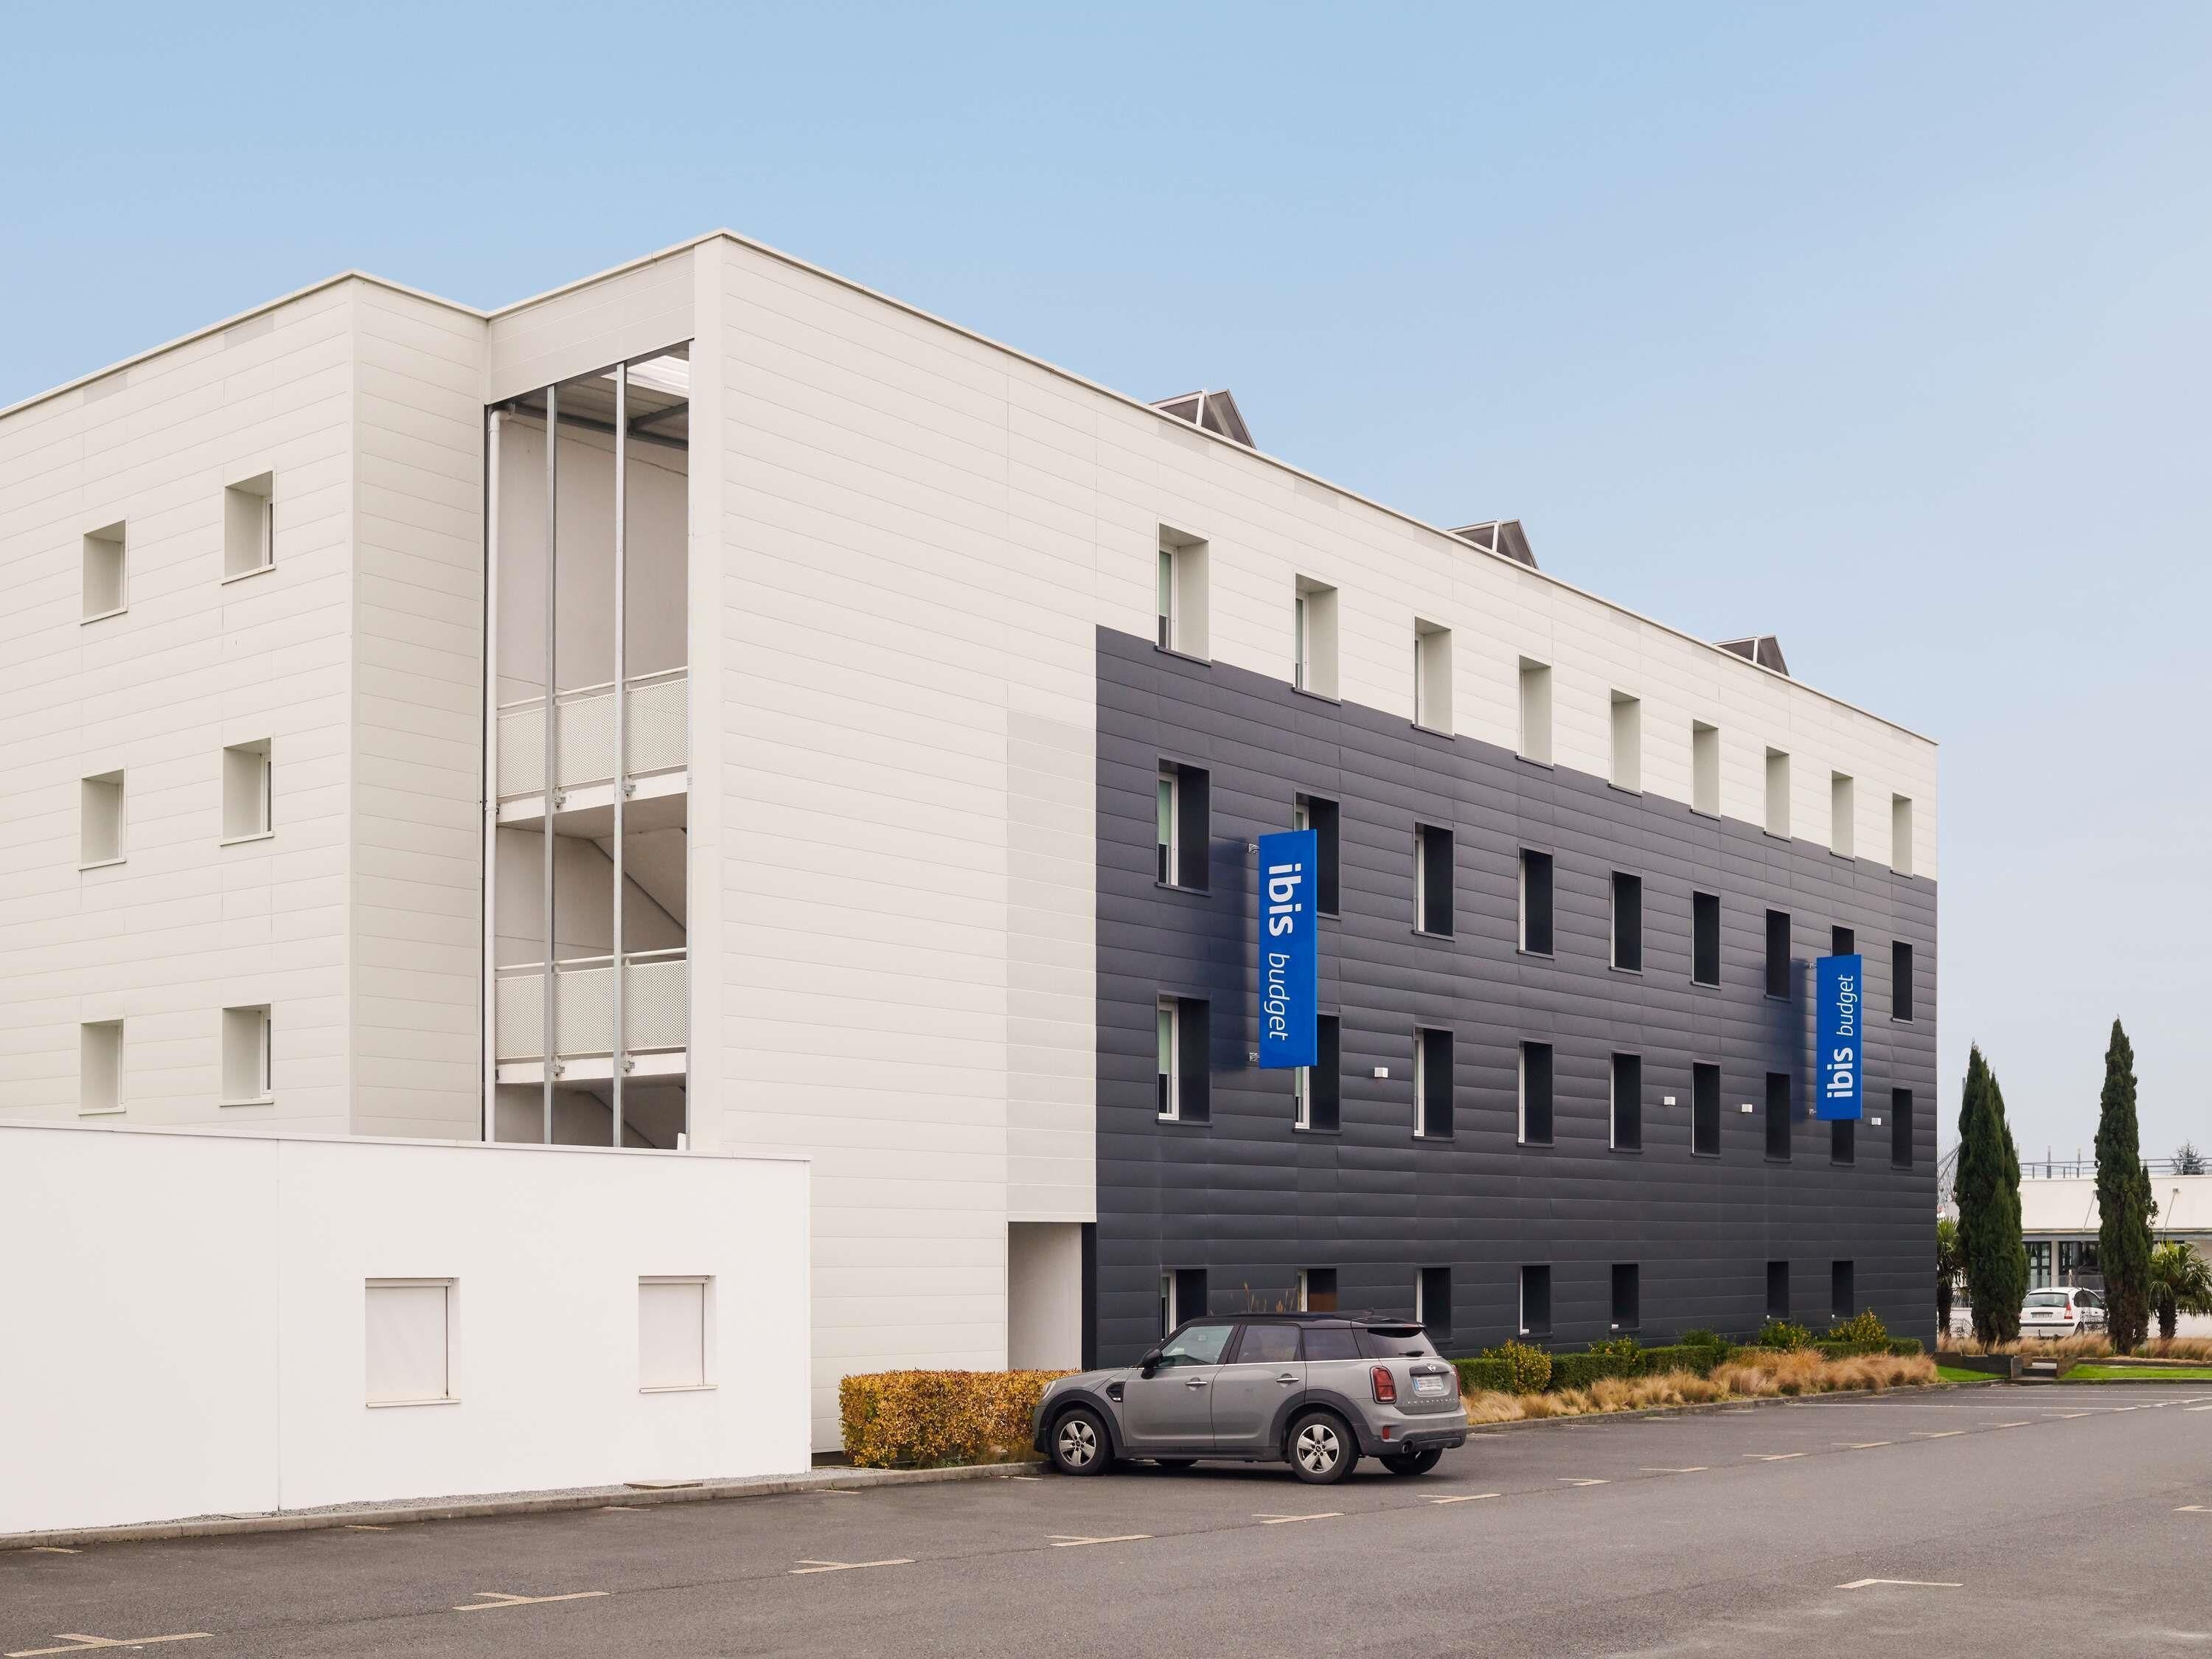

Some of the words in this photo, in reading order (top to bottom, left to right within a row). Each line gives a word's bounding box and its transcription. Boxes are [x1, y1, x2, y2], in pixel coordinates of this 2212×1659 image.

[1268, 863, 1302, 936] ibis
[1264, 953, 1290, 1041] budget
[1836, 974, 1857, 1037] budget
[1826, 1047, 1854, 1098] ibis
